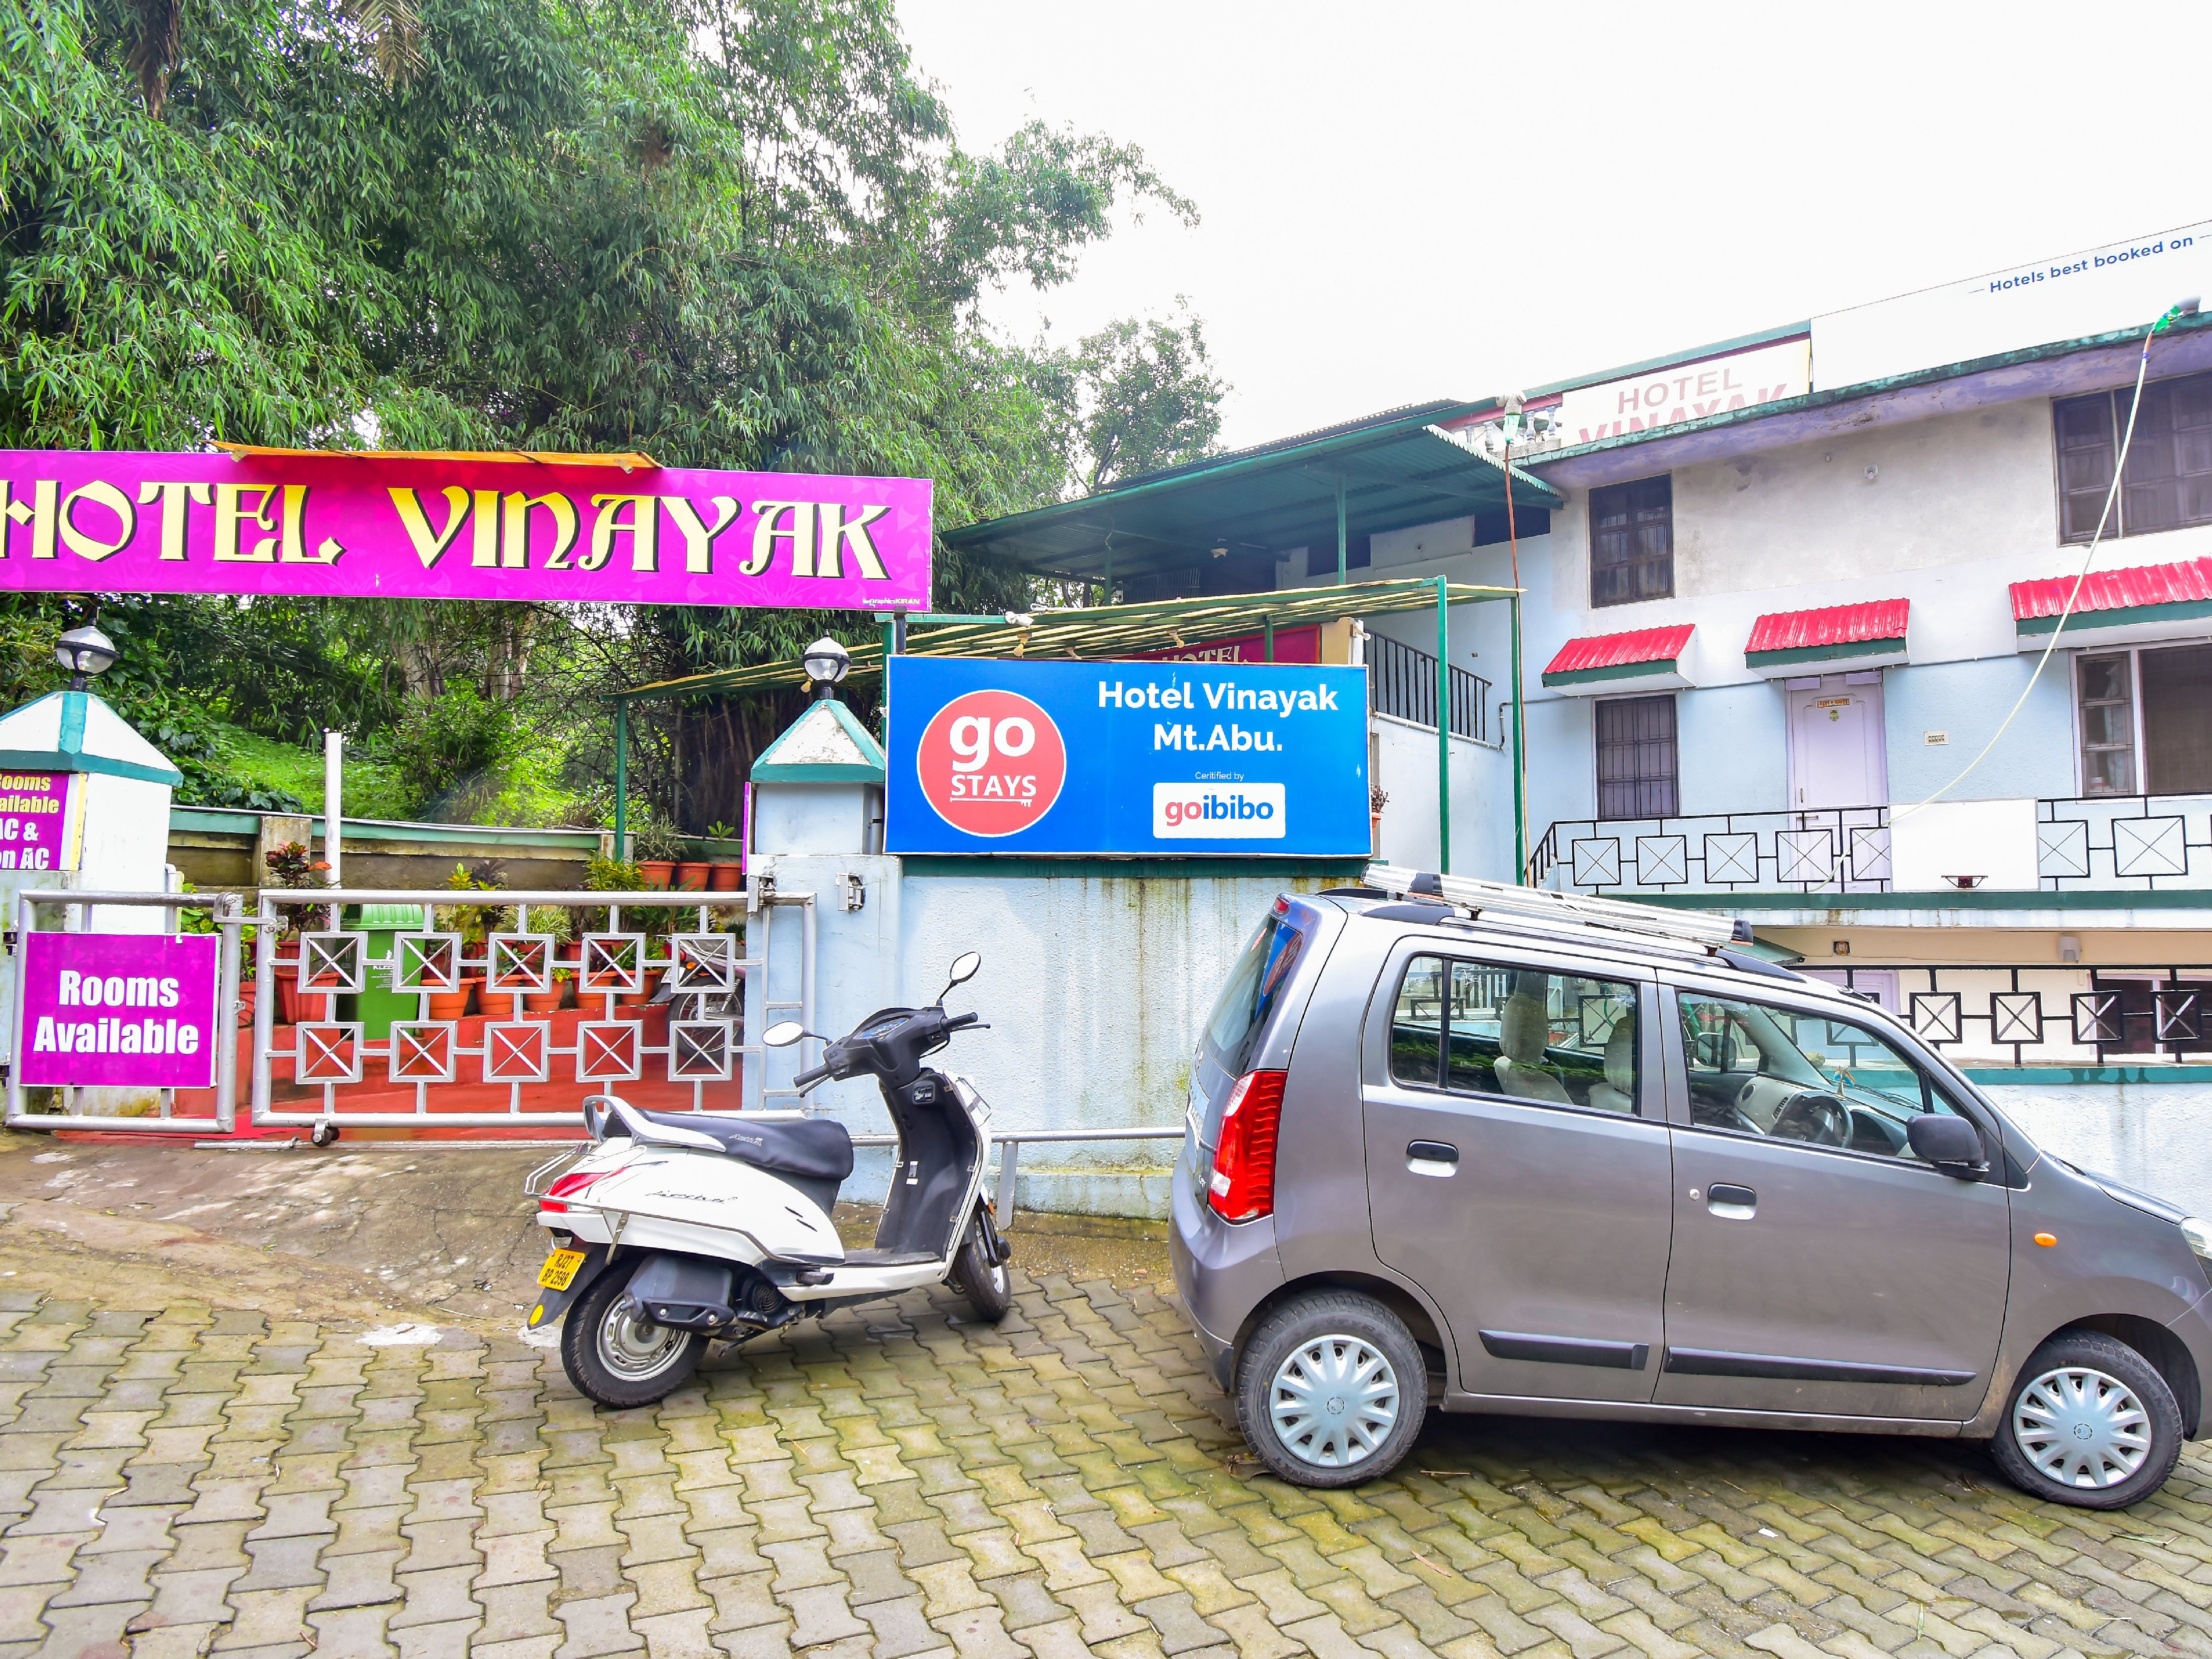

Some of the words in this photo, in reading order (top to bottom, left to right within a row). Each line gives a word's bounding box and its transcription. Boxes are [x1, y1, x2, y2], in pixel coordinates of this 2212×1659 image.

[1990, 270, 2044, 293] Hotels
[2050, 260, 2088, 278] best
[2093, 241, 2164, 268] booked
[2170, 237, 2194, 250] on
[1618, 368, 1743, 414] HOTEL
[0, 480, 347, 566] HOTEL
[387, 485, 892, 580] VINAYAK
[1097, 680, 1195, 709] Hotel
[1202, 682, 1339, 718] Vinayak
[949, 716, 1036, 773] go
[1153, 723, 1283, 752] Mt.Abu.
[0, 773, 52, 792] ooms
[951, 774, 1036, 797] STAYS
[1195, 771, 1232, 780] Ceritified
[1234, 771, 1244, 782] by
[1164, 795, 1274, 827] goibibo
[0, 818, 20, 841] C
[23, 822, 39, 841] &
[0, 850, 17, 869] n
[19, 847, 50, 870] AC
[59, 969, 179, 1008] Rooms
[33, 1016, 199, 1055] Available
[541, 1268, 554, 1282] BP
[554, 1254, 575, 1270] RJ27
